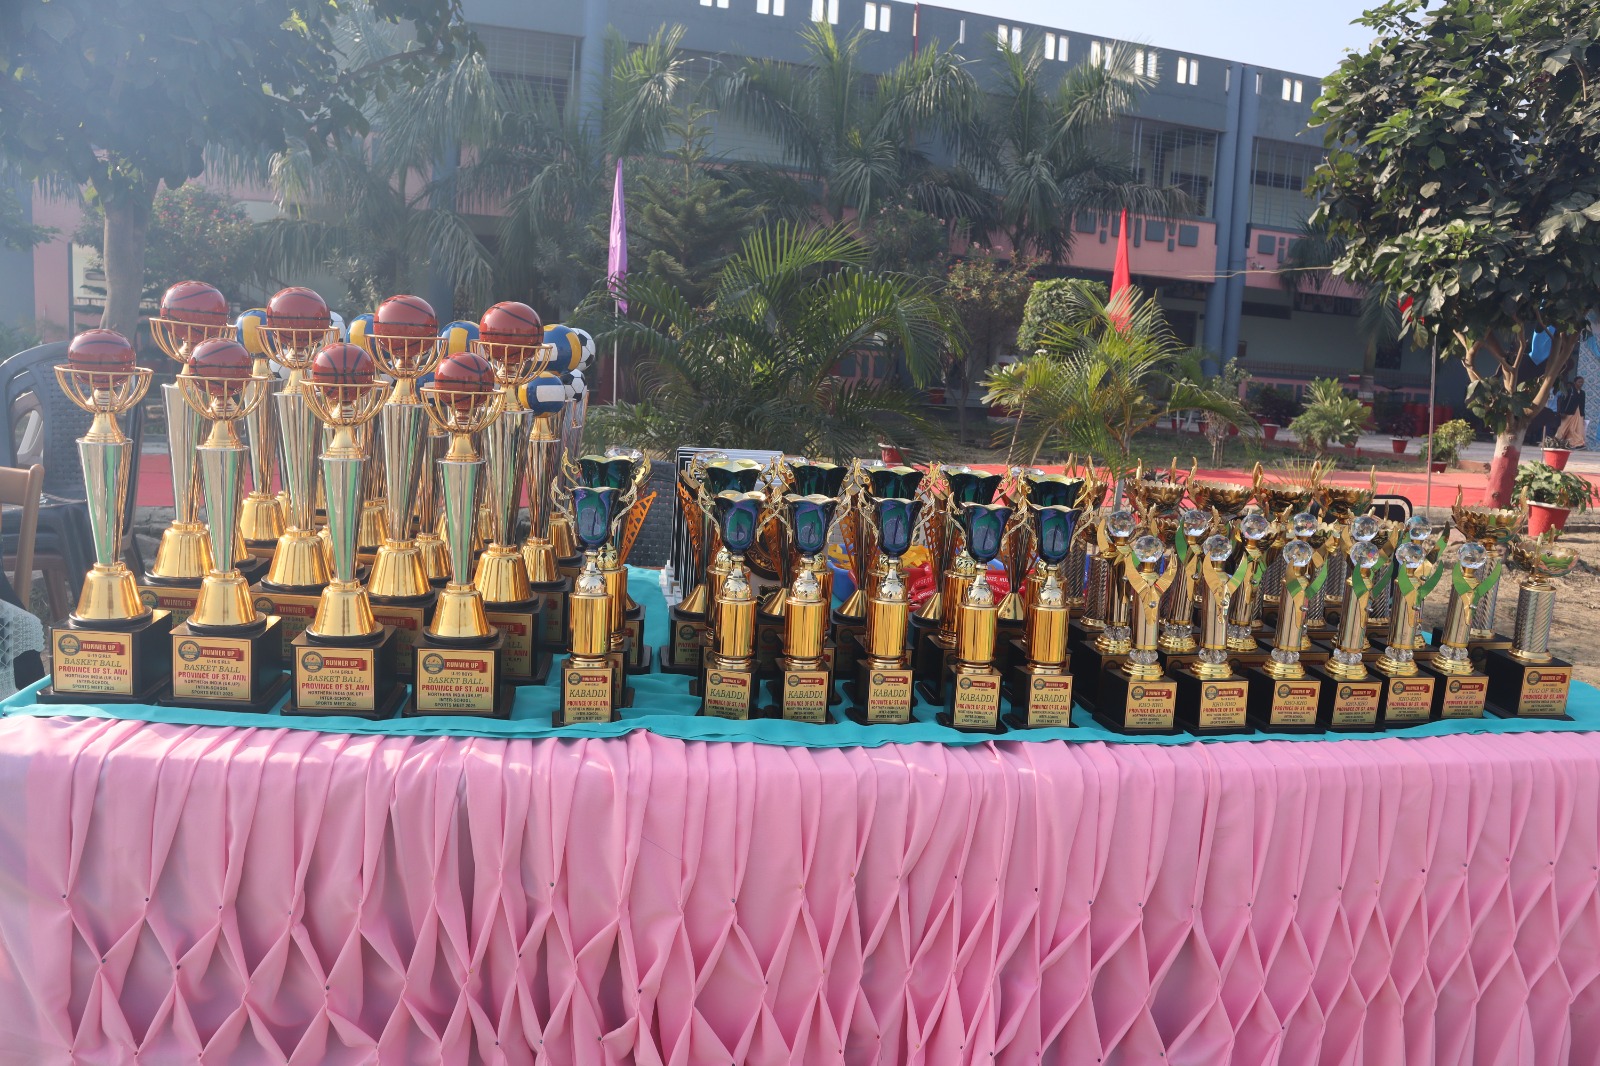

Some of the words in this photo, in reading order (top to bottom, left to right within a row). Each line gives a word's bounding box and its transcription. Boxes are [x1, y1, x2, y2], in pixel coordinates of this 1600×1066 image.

[64, 658, 98, 666] BASKET
[710, 689, 745, 700] KABADDI
[873, 689, 907, 697] KABADDI
[960, 693, 995, 702] KABADDI
[1034, 694, 1067, 702] KABADDI
